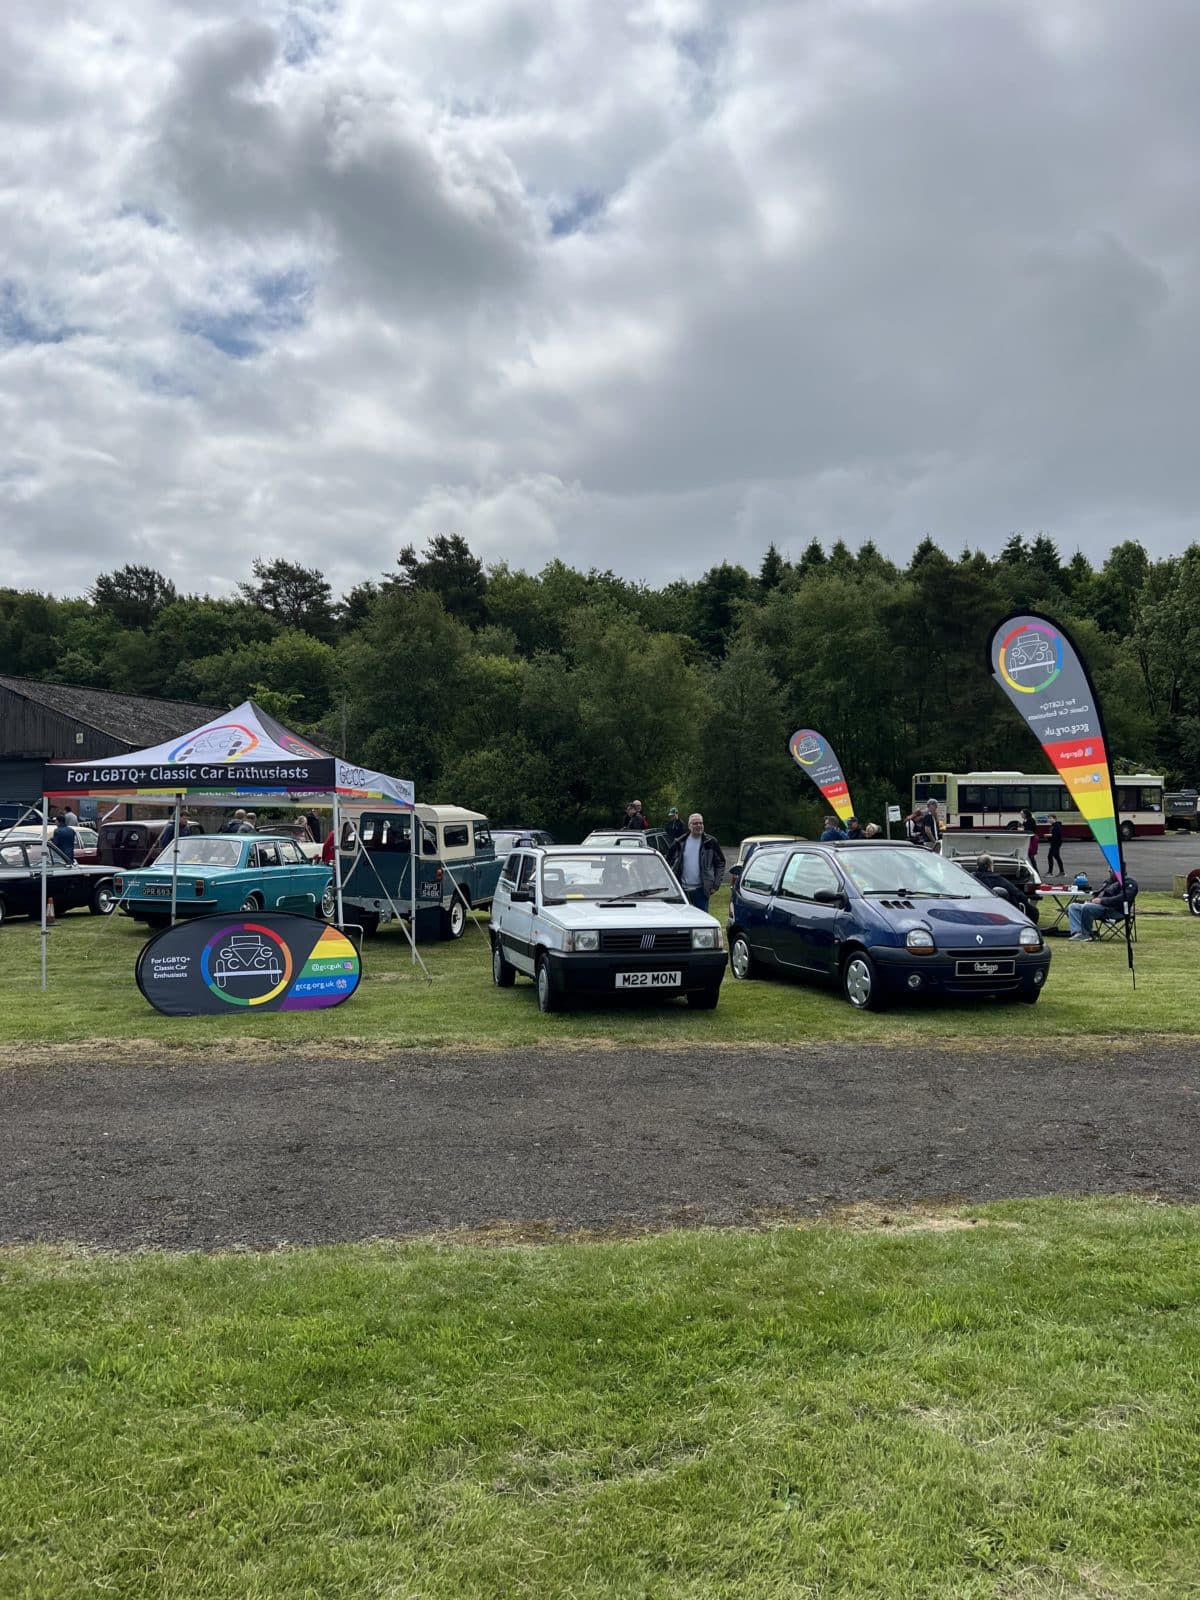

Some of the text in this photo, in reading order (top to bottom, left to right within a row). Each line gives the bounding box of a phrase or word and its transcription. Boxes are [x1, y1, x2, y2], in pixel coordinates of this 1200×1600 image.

[67, 766, 309, 783] For LGBTQ+ Classic Car Enthusiasts
[162, 956, 190, 964] LGBTQ+
[153, 964, 175, 972] Classic
[622, 973, 677, 986] M22 MON
[295, 980, 335, 992] gccg.org.uk
